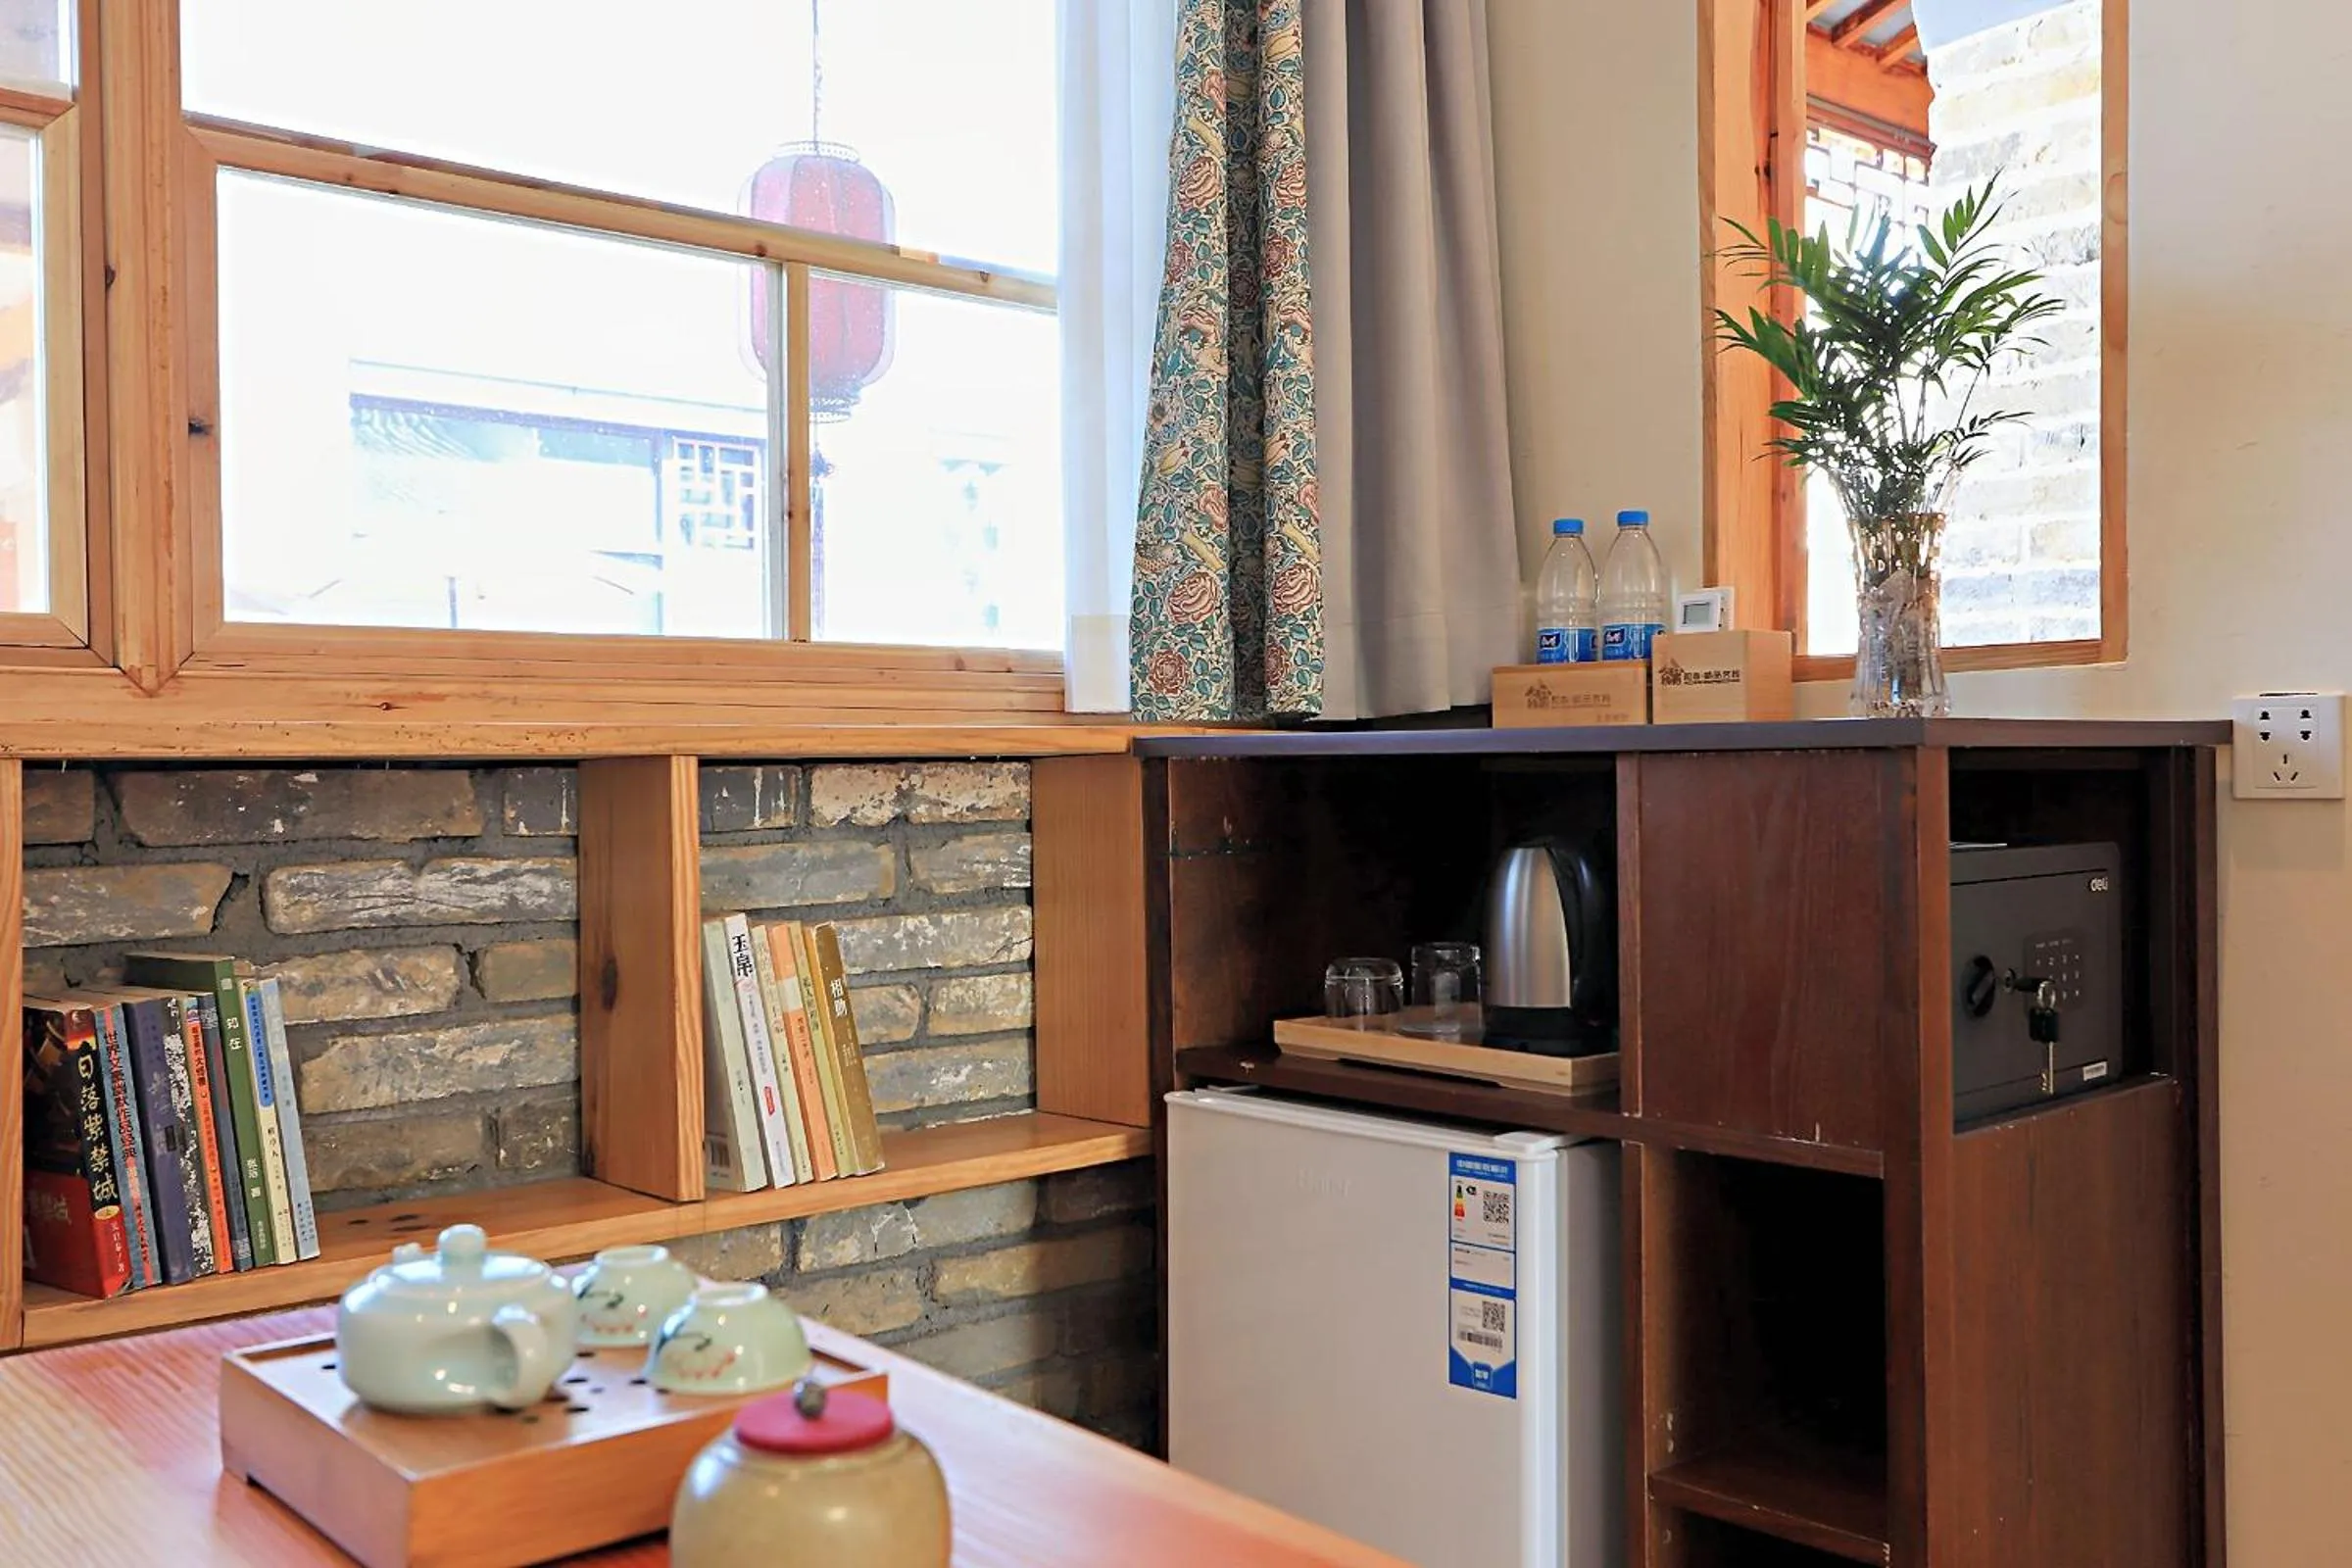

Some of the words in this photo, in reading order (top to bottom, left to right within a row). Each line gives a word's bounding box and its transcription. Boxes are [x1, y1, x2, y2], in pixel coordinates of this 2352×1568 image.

[2089, 876, 2108, 891] deli
[77, 1054, 119, 1201] 日落紫禁城
